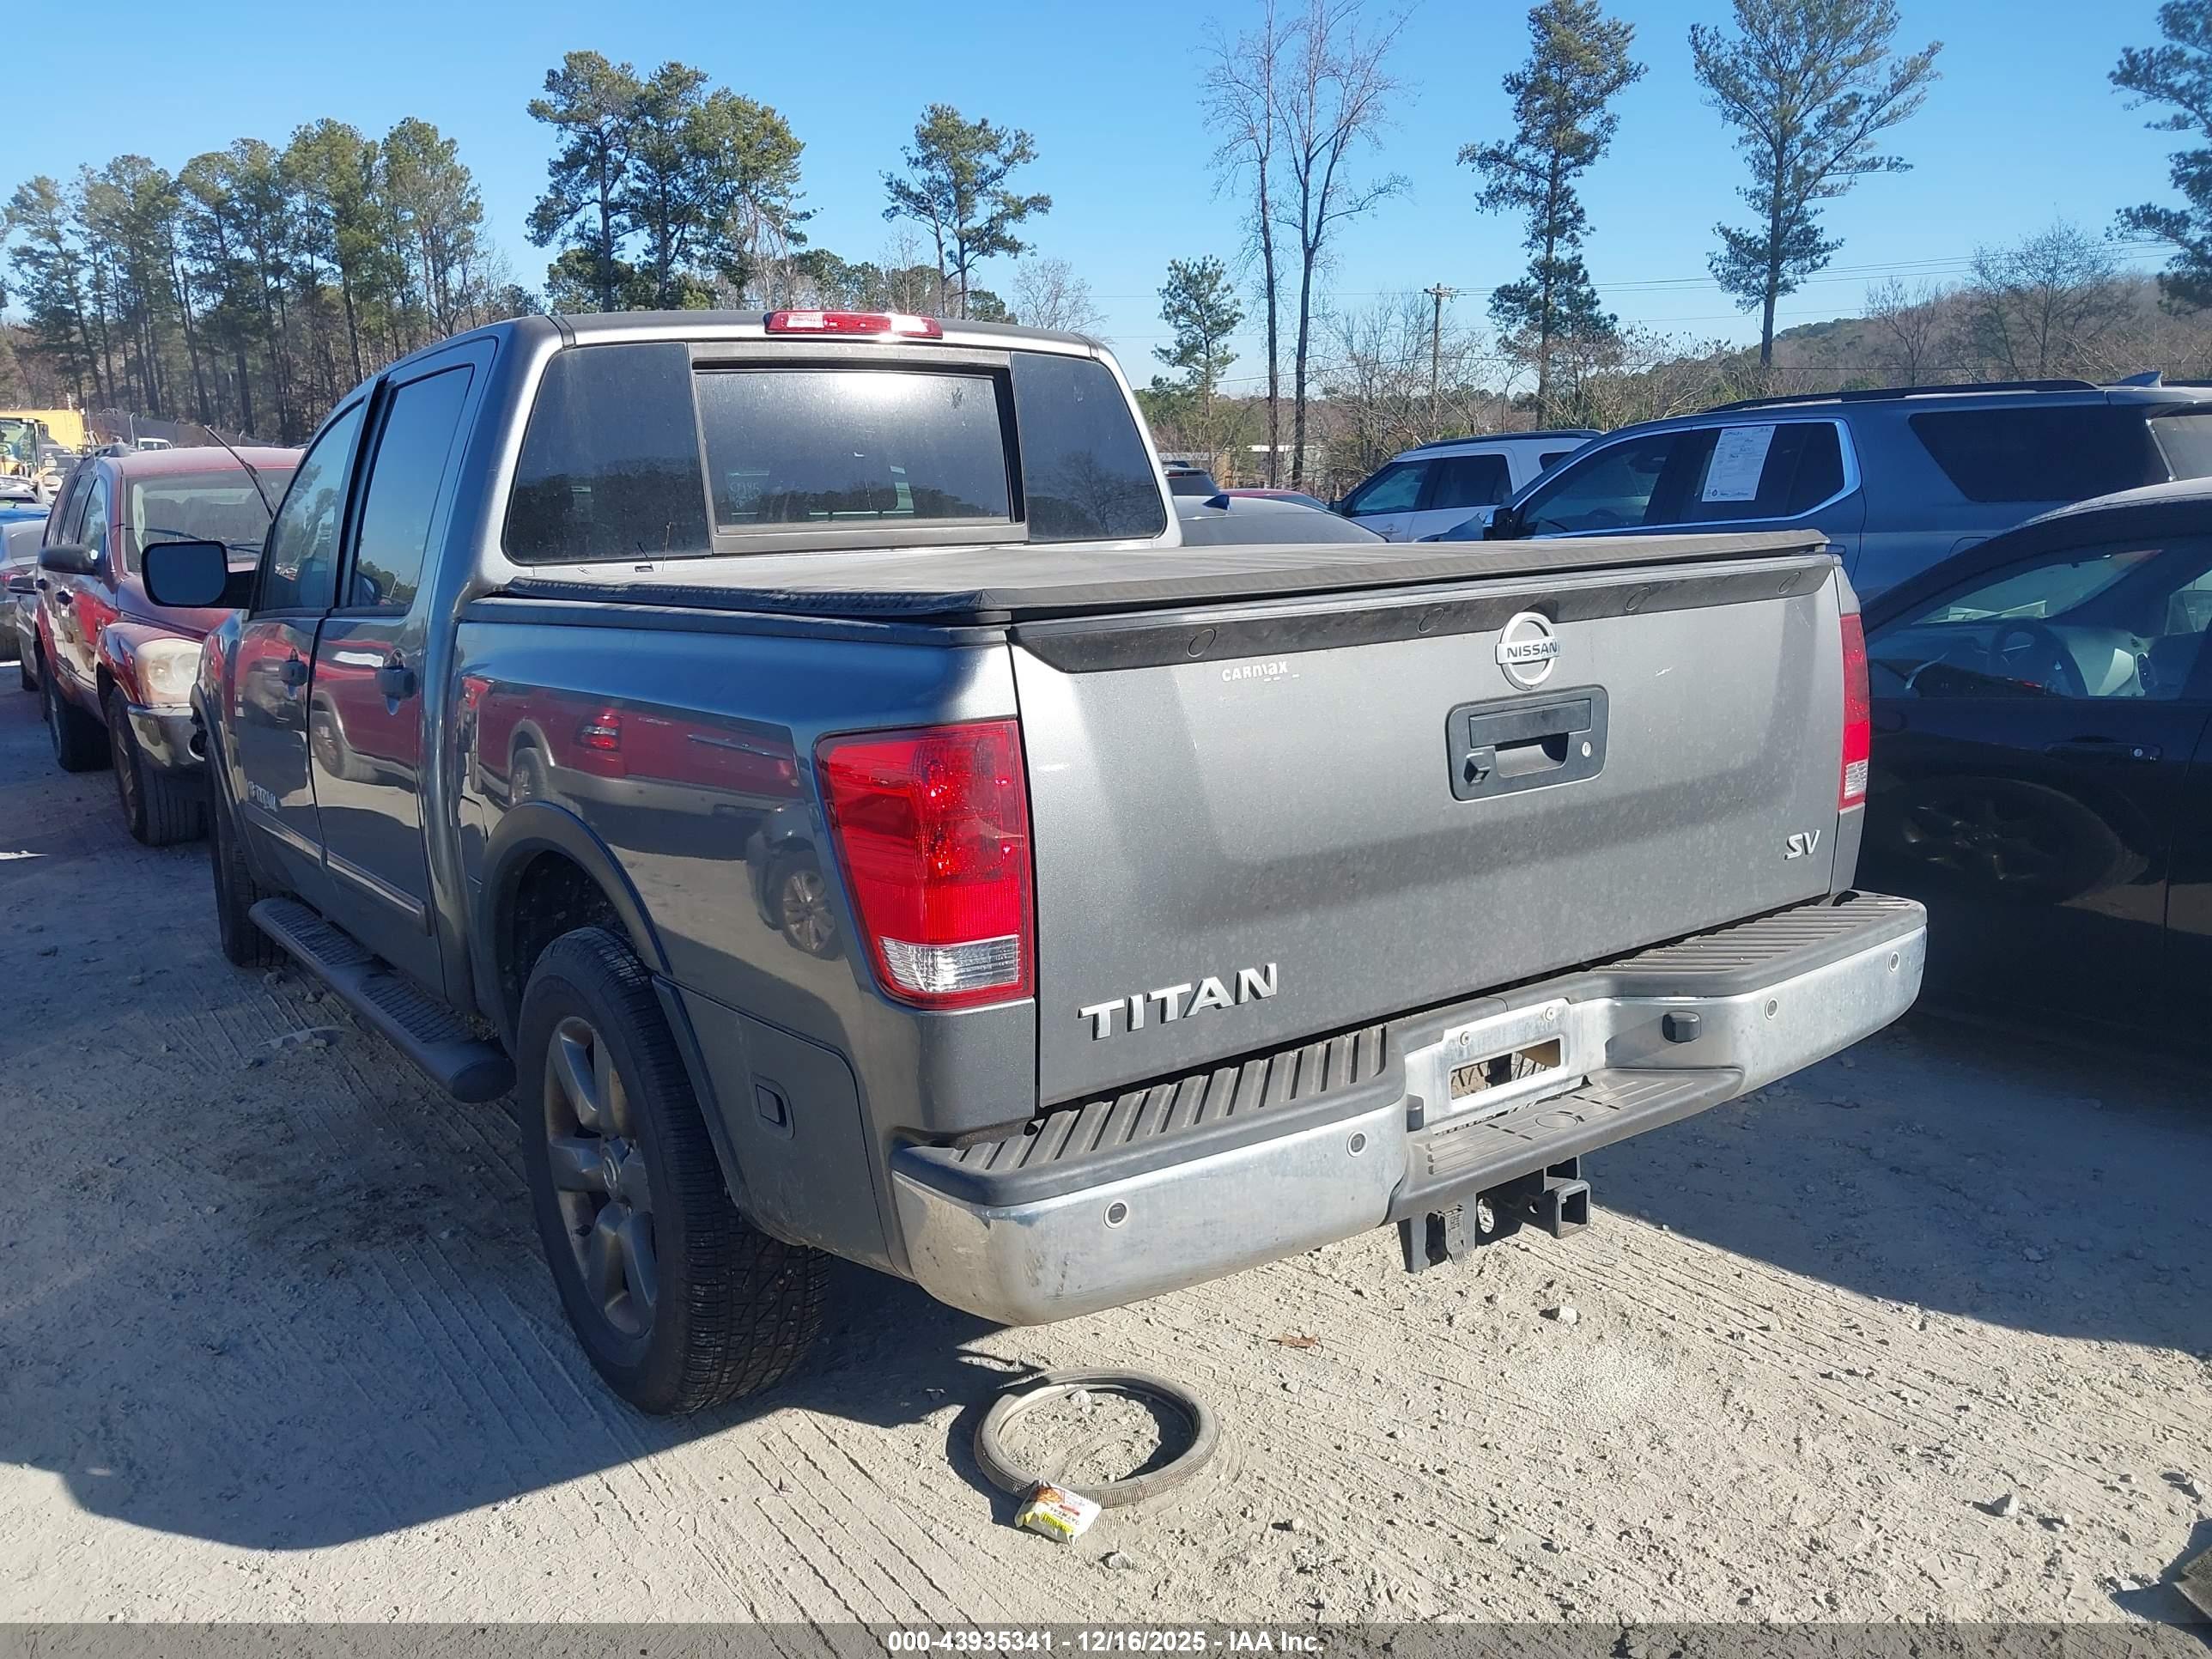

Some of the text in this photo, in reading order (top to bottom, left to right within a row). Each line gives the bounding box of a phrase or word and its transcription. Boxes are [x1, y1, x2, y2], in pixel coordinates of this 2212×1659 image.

[1507, 641, 1559, 659] NISSAN
[1784, 830, 1820, 860] SV
[1078, 963, 1278, 1041] TITAN
